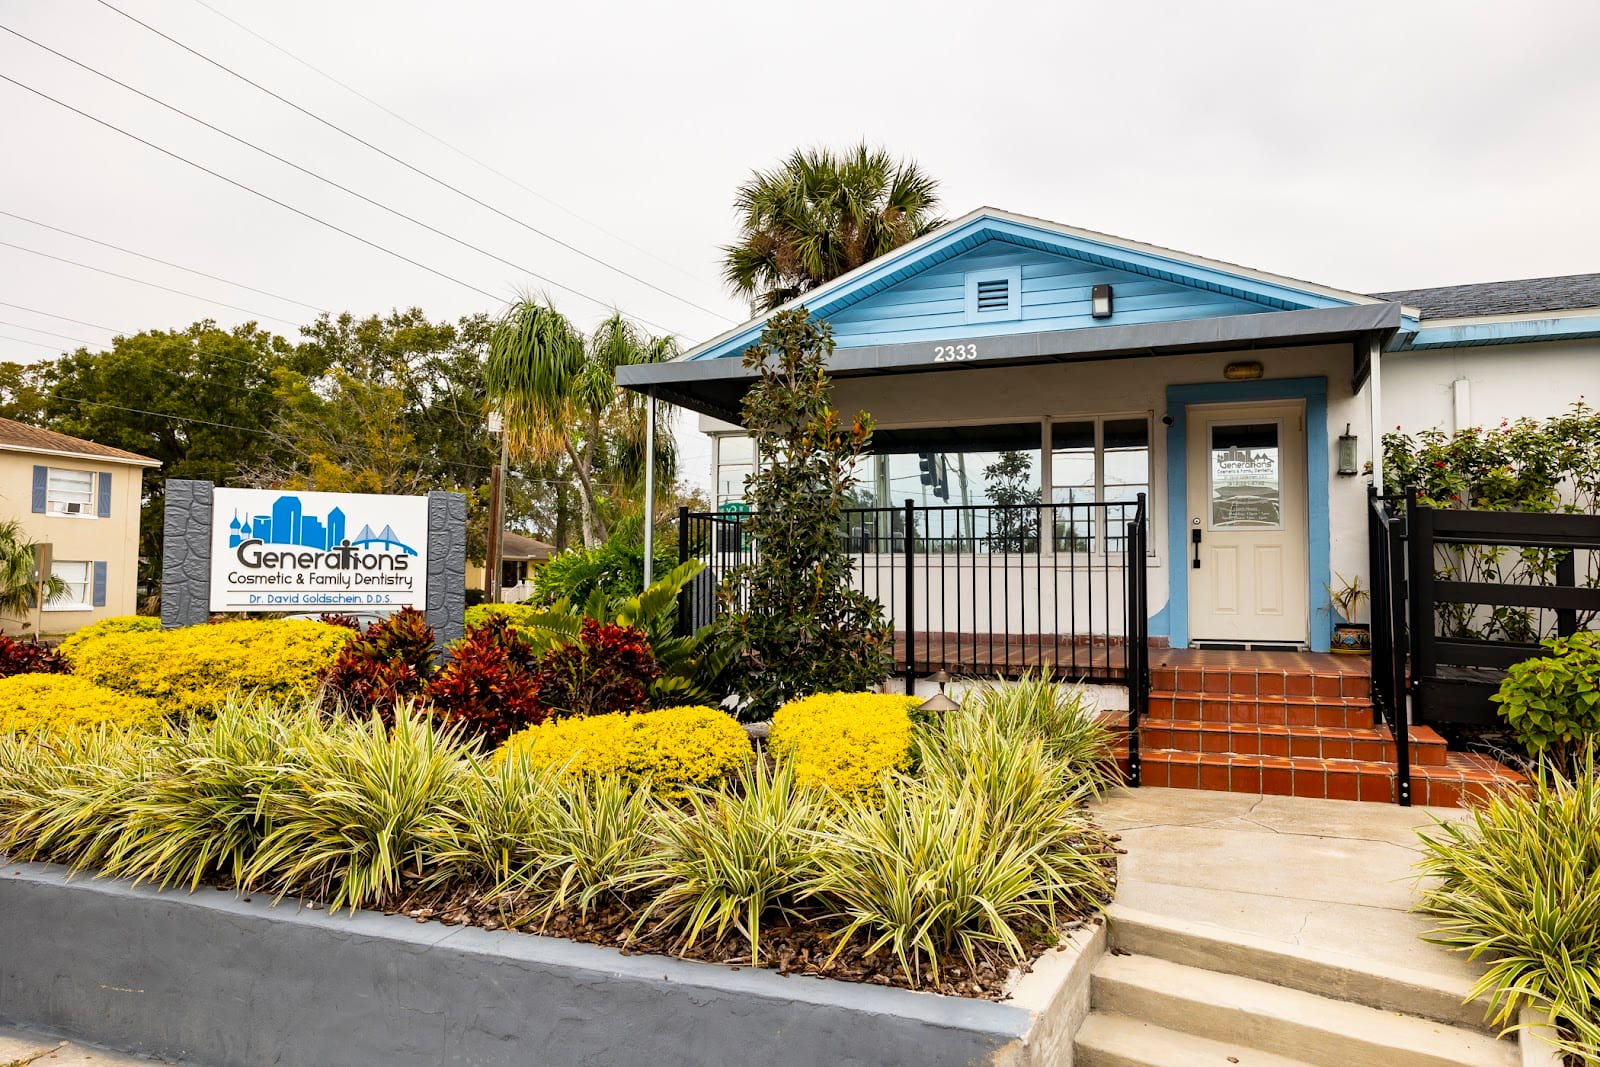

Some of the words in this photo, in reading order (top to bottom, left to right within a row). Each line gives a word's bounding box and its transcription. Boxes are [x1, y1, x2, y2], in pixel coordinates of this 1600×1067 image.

[934, 343, 977, 362] 2333
[237, 539, 409, 571] Generations
[228, 571, 292, 585] Cosmetic
[296, 573, 305, 585] &
[309, 572, 351, 589] Family
[354, 572, 413, 589] Dentistry
[249, 594, 263, 604] Dr.
[267, 594, 299, 604] David
[366, 594, 393, 604] D.D.S.
